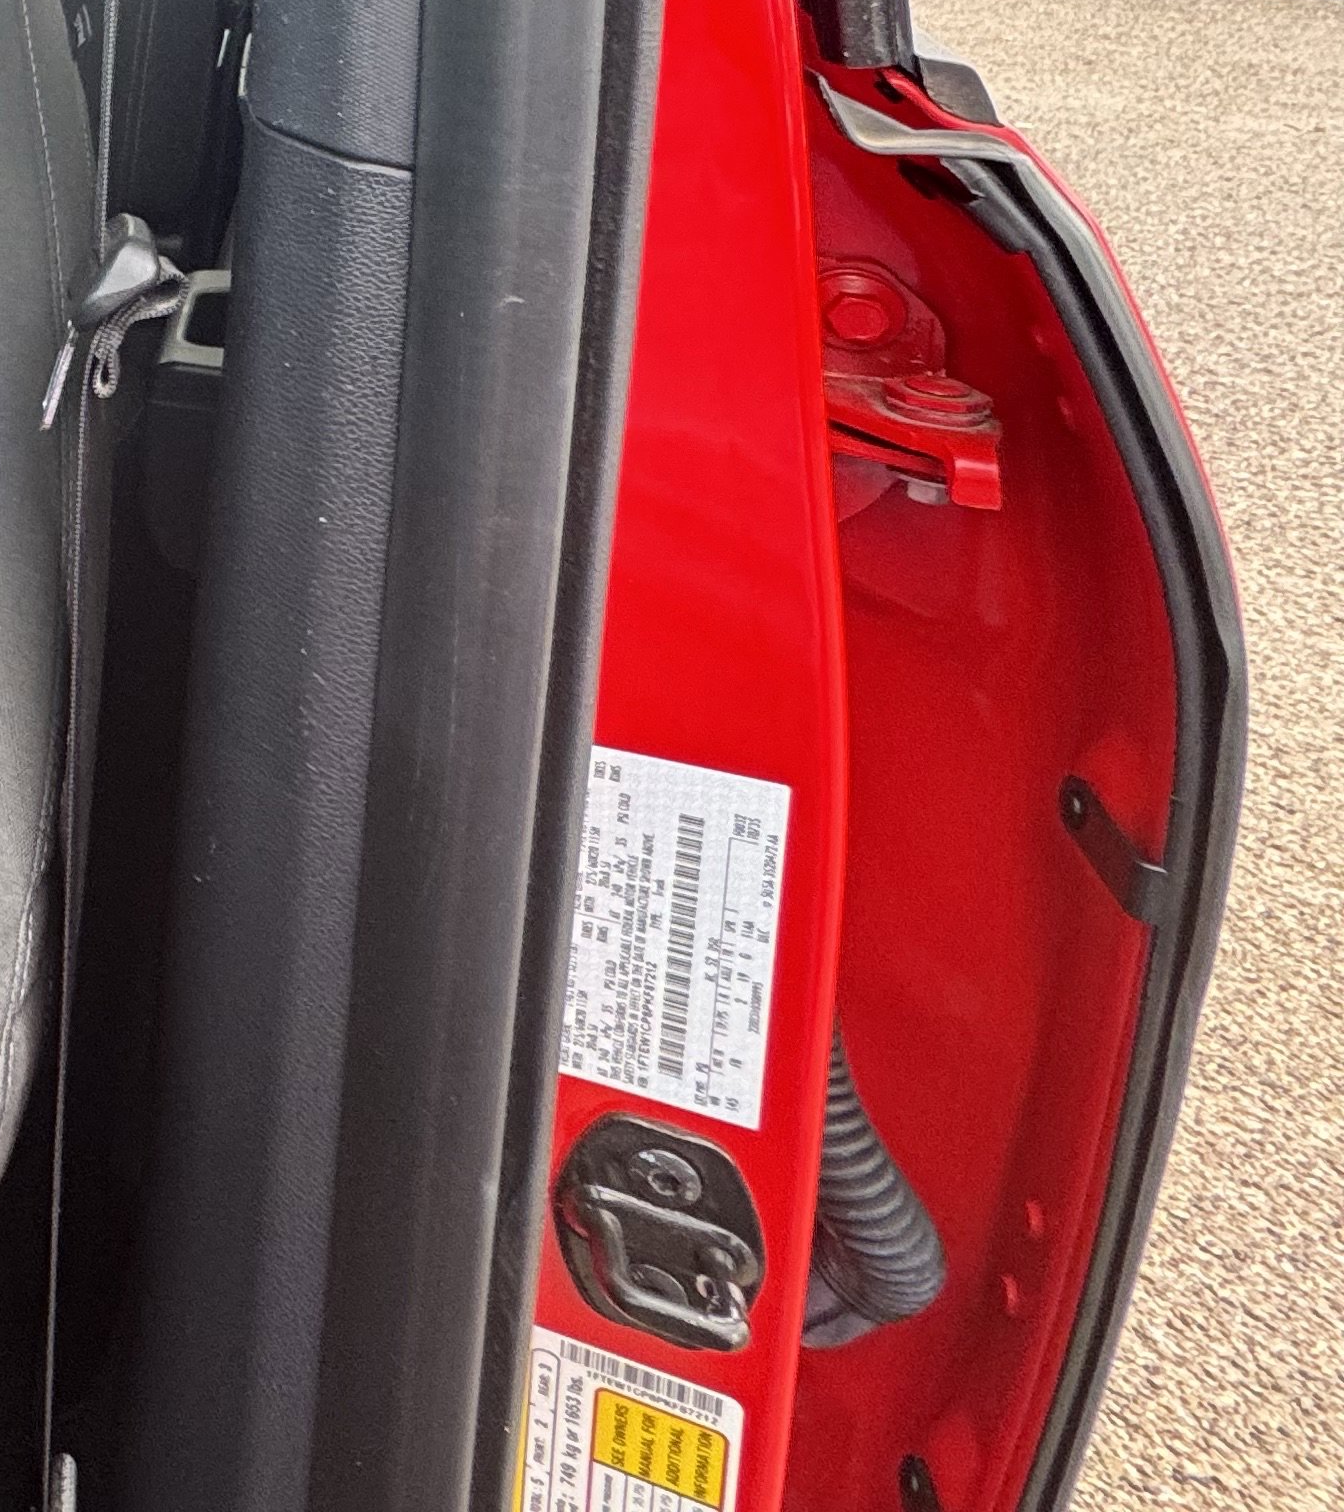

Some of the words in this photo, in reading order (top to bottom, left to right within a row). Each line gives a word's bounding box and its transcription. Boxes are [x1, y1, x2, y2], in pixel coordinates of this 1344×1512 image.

[564, 1396, 582, 1426] 1653
[611, 1447, 625, 1467] SEE
[638, 1438, 655, 1478] MANUAL
[665, 1426, 684, 1487] ADDITIONAL
[693, 1431, 712, 1498] INFORMATION
[560, 1463, 577, 1487] 749
